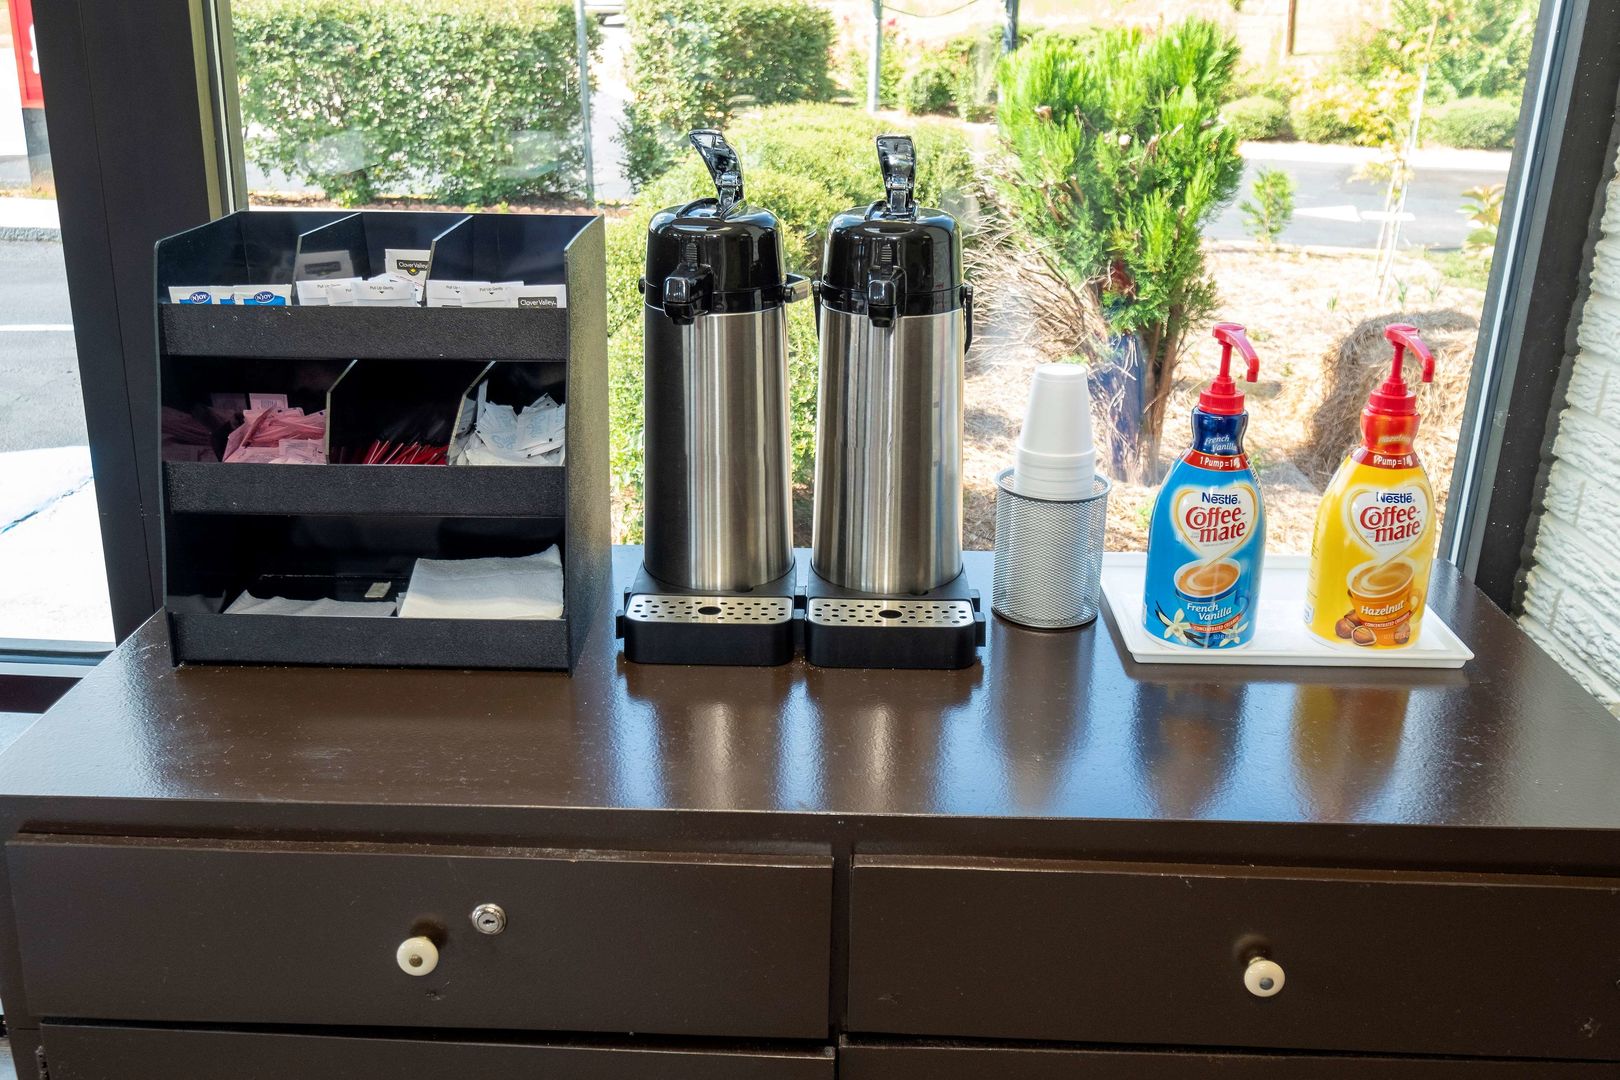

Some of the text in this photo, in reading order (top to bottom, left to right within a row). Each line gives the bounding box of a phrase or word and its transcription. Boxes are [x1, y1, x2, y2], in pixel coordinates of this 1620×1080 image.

[1204, 434, 1230, 446] French
[1204, 456, 1224, 469] Pump
[1377, 455, 1397, 468] Pump
[1202, 492, 1238, 505] Nestlé
[1376, 491, 1413, 504] Nestlé
[1199, 522, 1246, 543] mate
[1375, 520, 1420, 543] mate
[1187, 602, 1219, 612] French
[1360, 600, 1405, 616] Hazelnut
[1198, 607, 1232, 621] Vanilla
